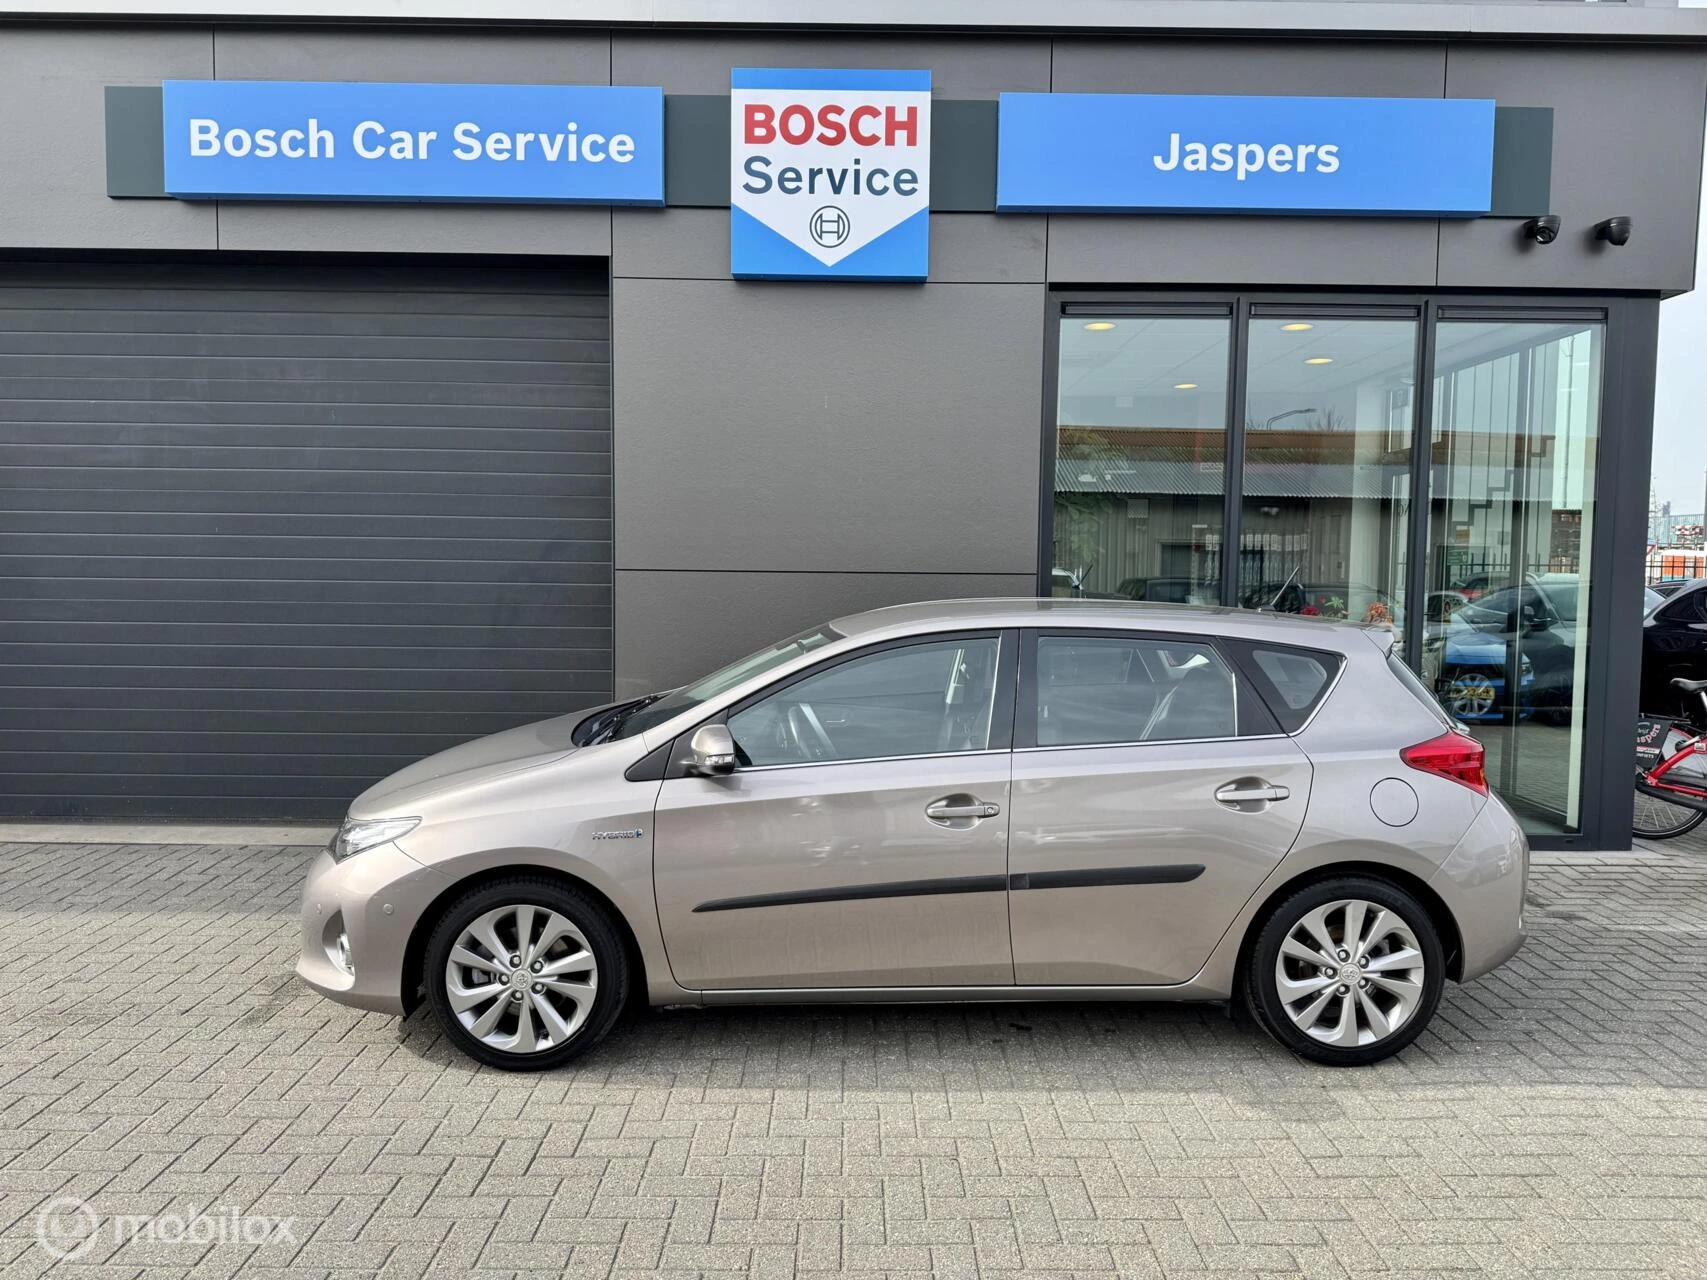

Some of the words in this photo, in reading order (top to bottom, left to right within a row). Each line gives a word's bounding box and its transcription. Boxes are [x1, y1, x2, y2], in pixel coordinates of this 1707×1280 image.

[190, 118, 335, 158] Bosch
[352, 120, 438, 160] Car
[452, 122, 636, 163] Service
[744, 103, 918, 147] BOSCH
[742, 155, 919, 197] Service
[1153, 133, 1340, 181] Jaspers
